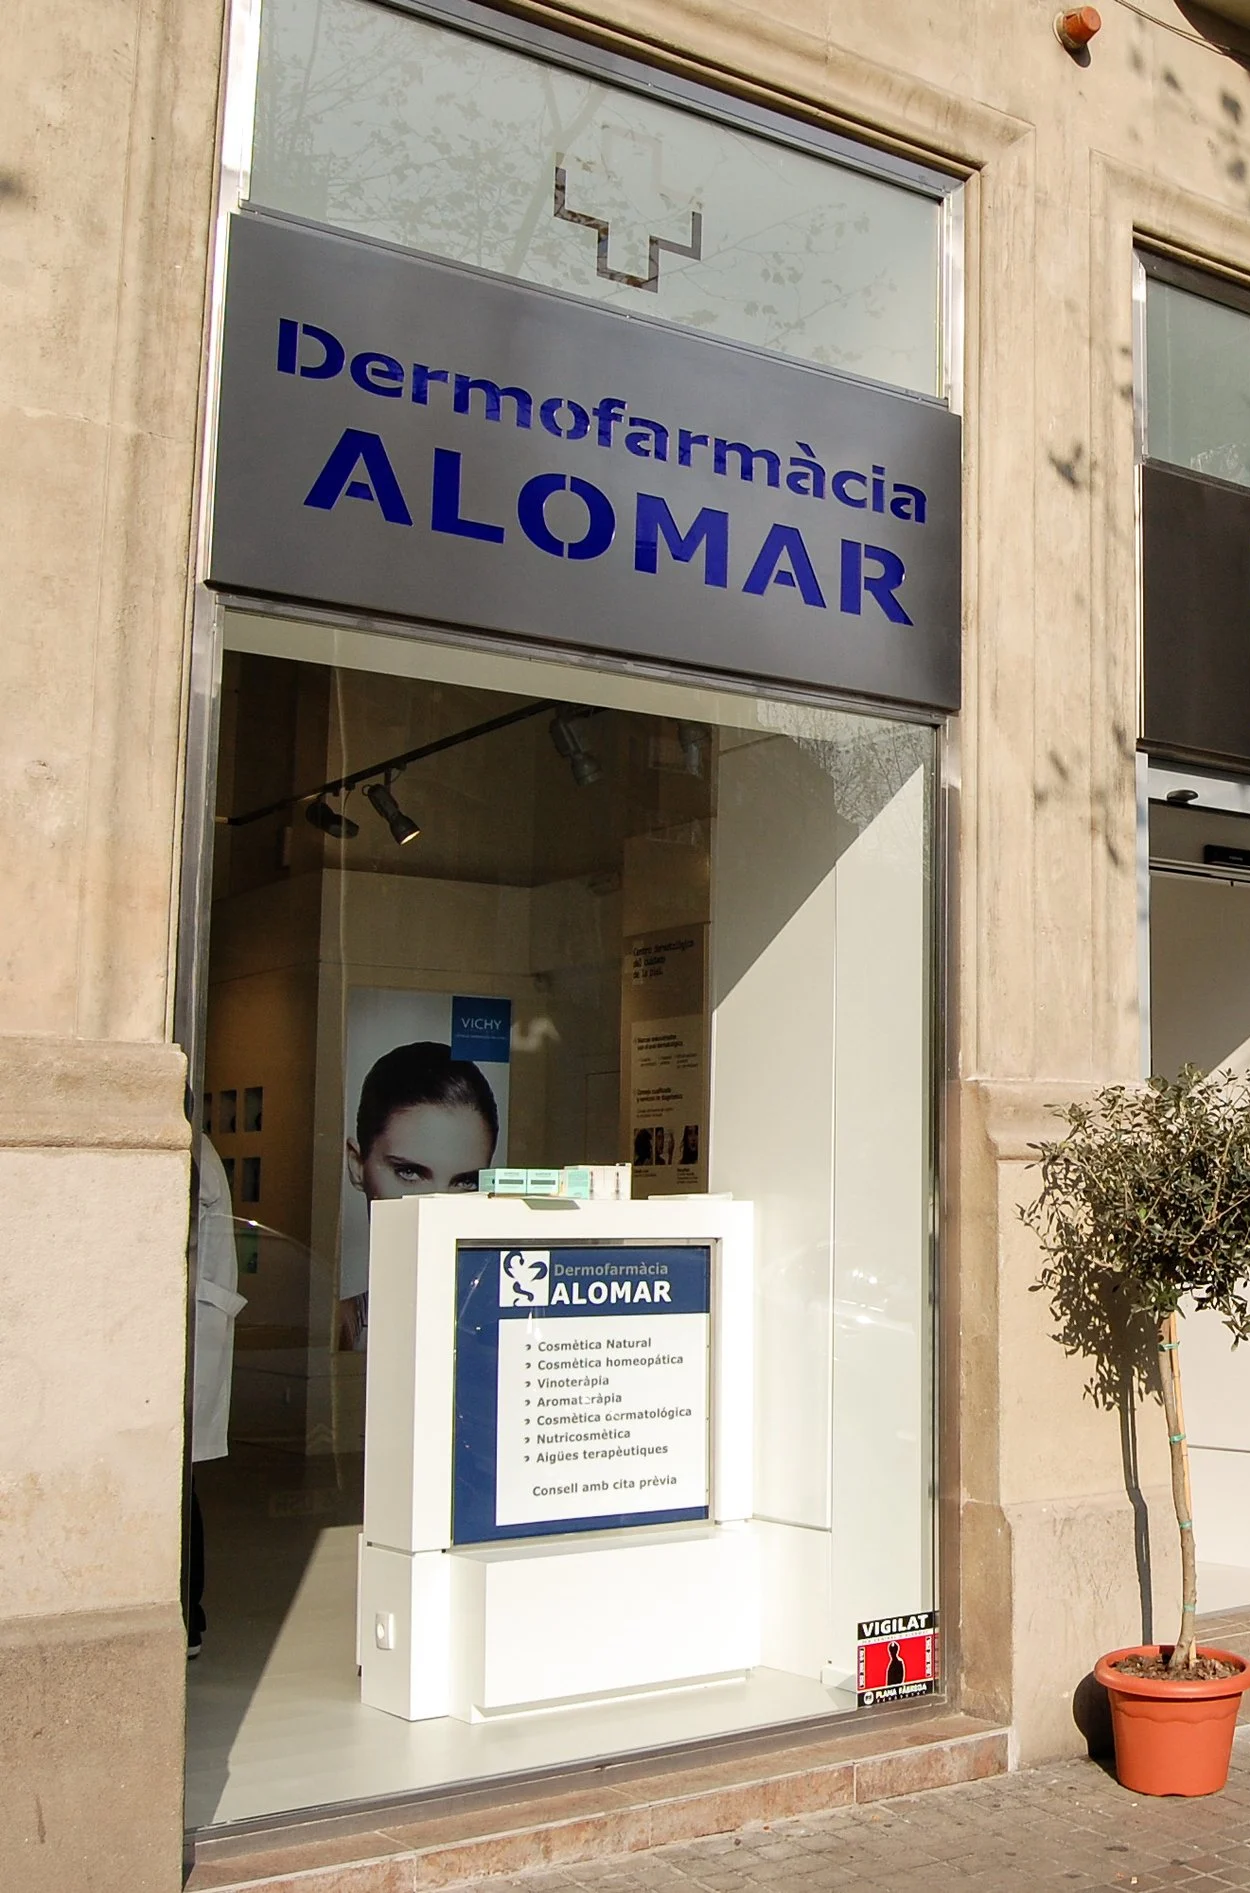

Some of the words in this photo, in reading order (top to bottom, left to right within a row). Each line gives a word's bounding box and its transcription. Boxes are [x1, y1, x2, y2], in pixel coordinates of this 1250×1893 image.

[276, 317, 927, 525] Dermofarmàcia
[302, 427, 915, 627] ALOMAR
[461, 1017, 502, 1030] VICHY
[554, 1262, 669, 1277] Dermofarmàcia
[550, 1280, 673, 1306] ALOMAR
[538, 1339, 602, 1353] Cosmètica
[606, 1336, 652, 1350] Natural
[538, 1357, 602, 1371] Cosmètica
[538, 1374, 610, 1390] Vinoteràpia
[537, 1412, 602, 1426] Cosmètica
[537, 1428, 631, 1445] Nutricosmètica
[536, 1449, 579, 1465] Aigües
[583, 1444, 669, 1461] terapèutiques
[532, 1482, 578, 1497] Consell
[582, 1480, 609, 1493] amb
[613, 1477, 635, 1490] cita
[639, 1474, 677, 1491] prèvia
[862, 1614, 929, 1637] VIGILAT
